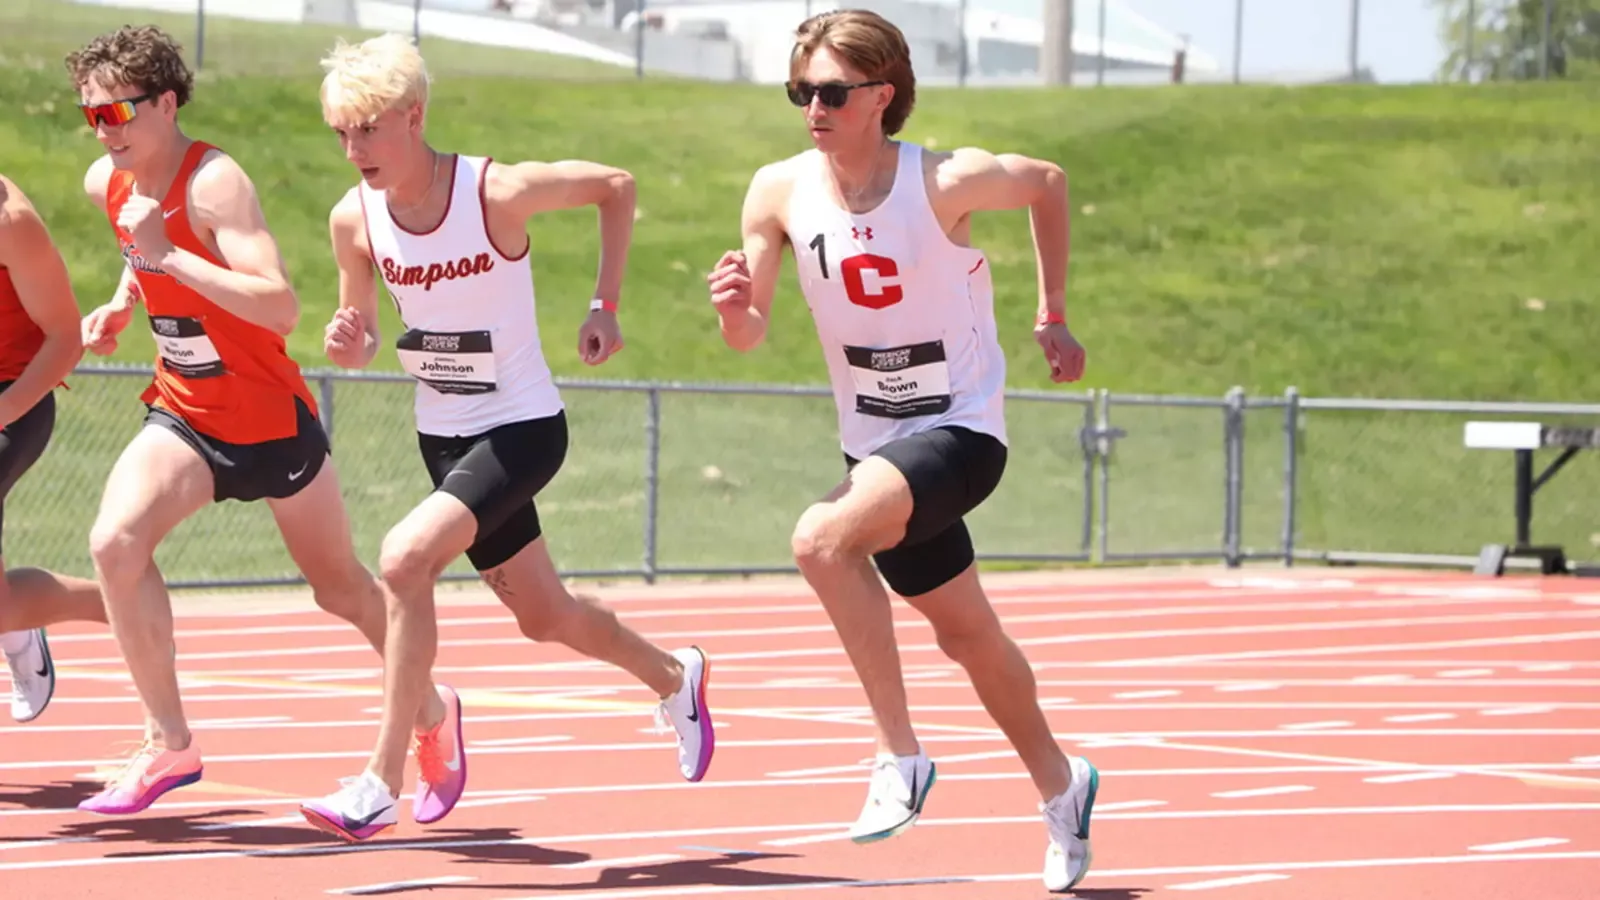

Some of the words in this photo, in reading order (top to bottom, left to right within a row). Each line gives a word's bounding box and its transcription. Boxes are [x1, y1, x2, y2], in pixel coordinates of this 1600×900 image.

[382, 252, 494, 291] Simpson
[808, 233, 829, 279] 1
[840, 253, 903, 310] C
[420, 362, 474, 373] Johnson
[877, 380, 918, 393] Brown
